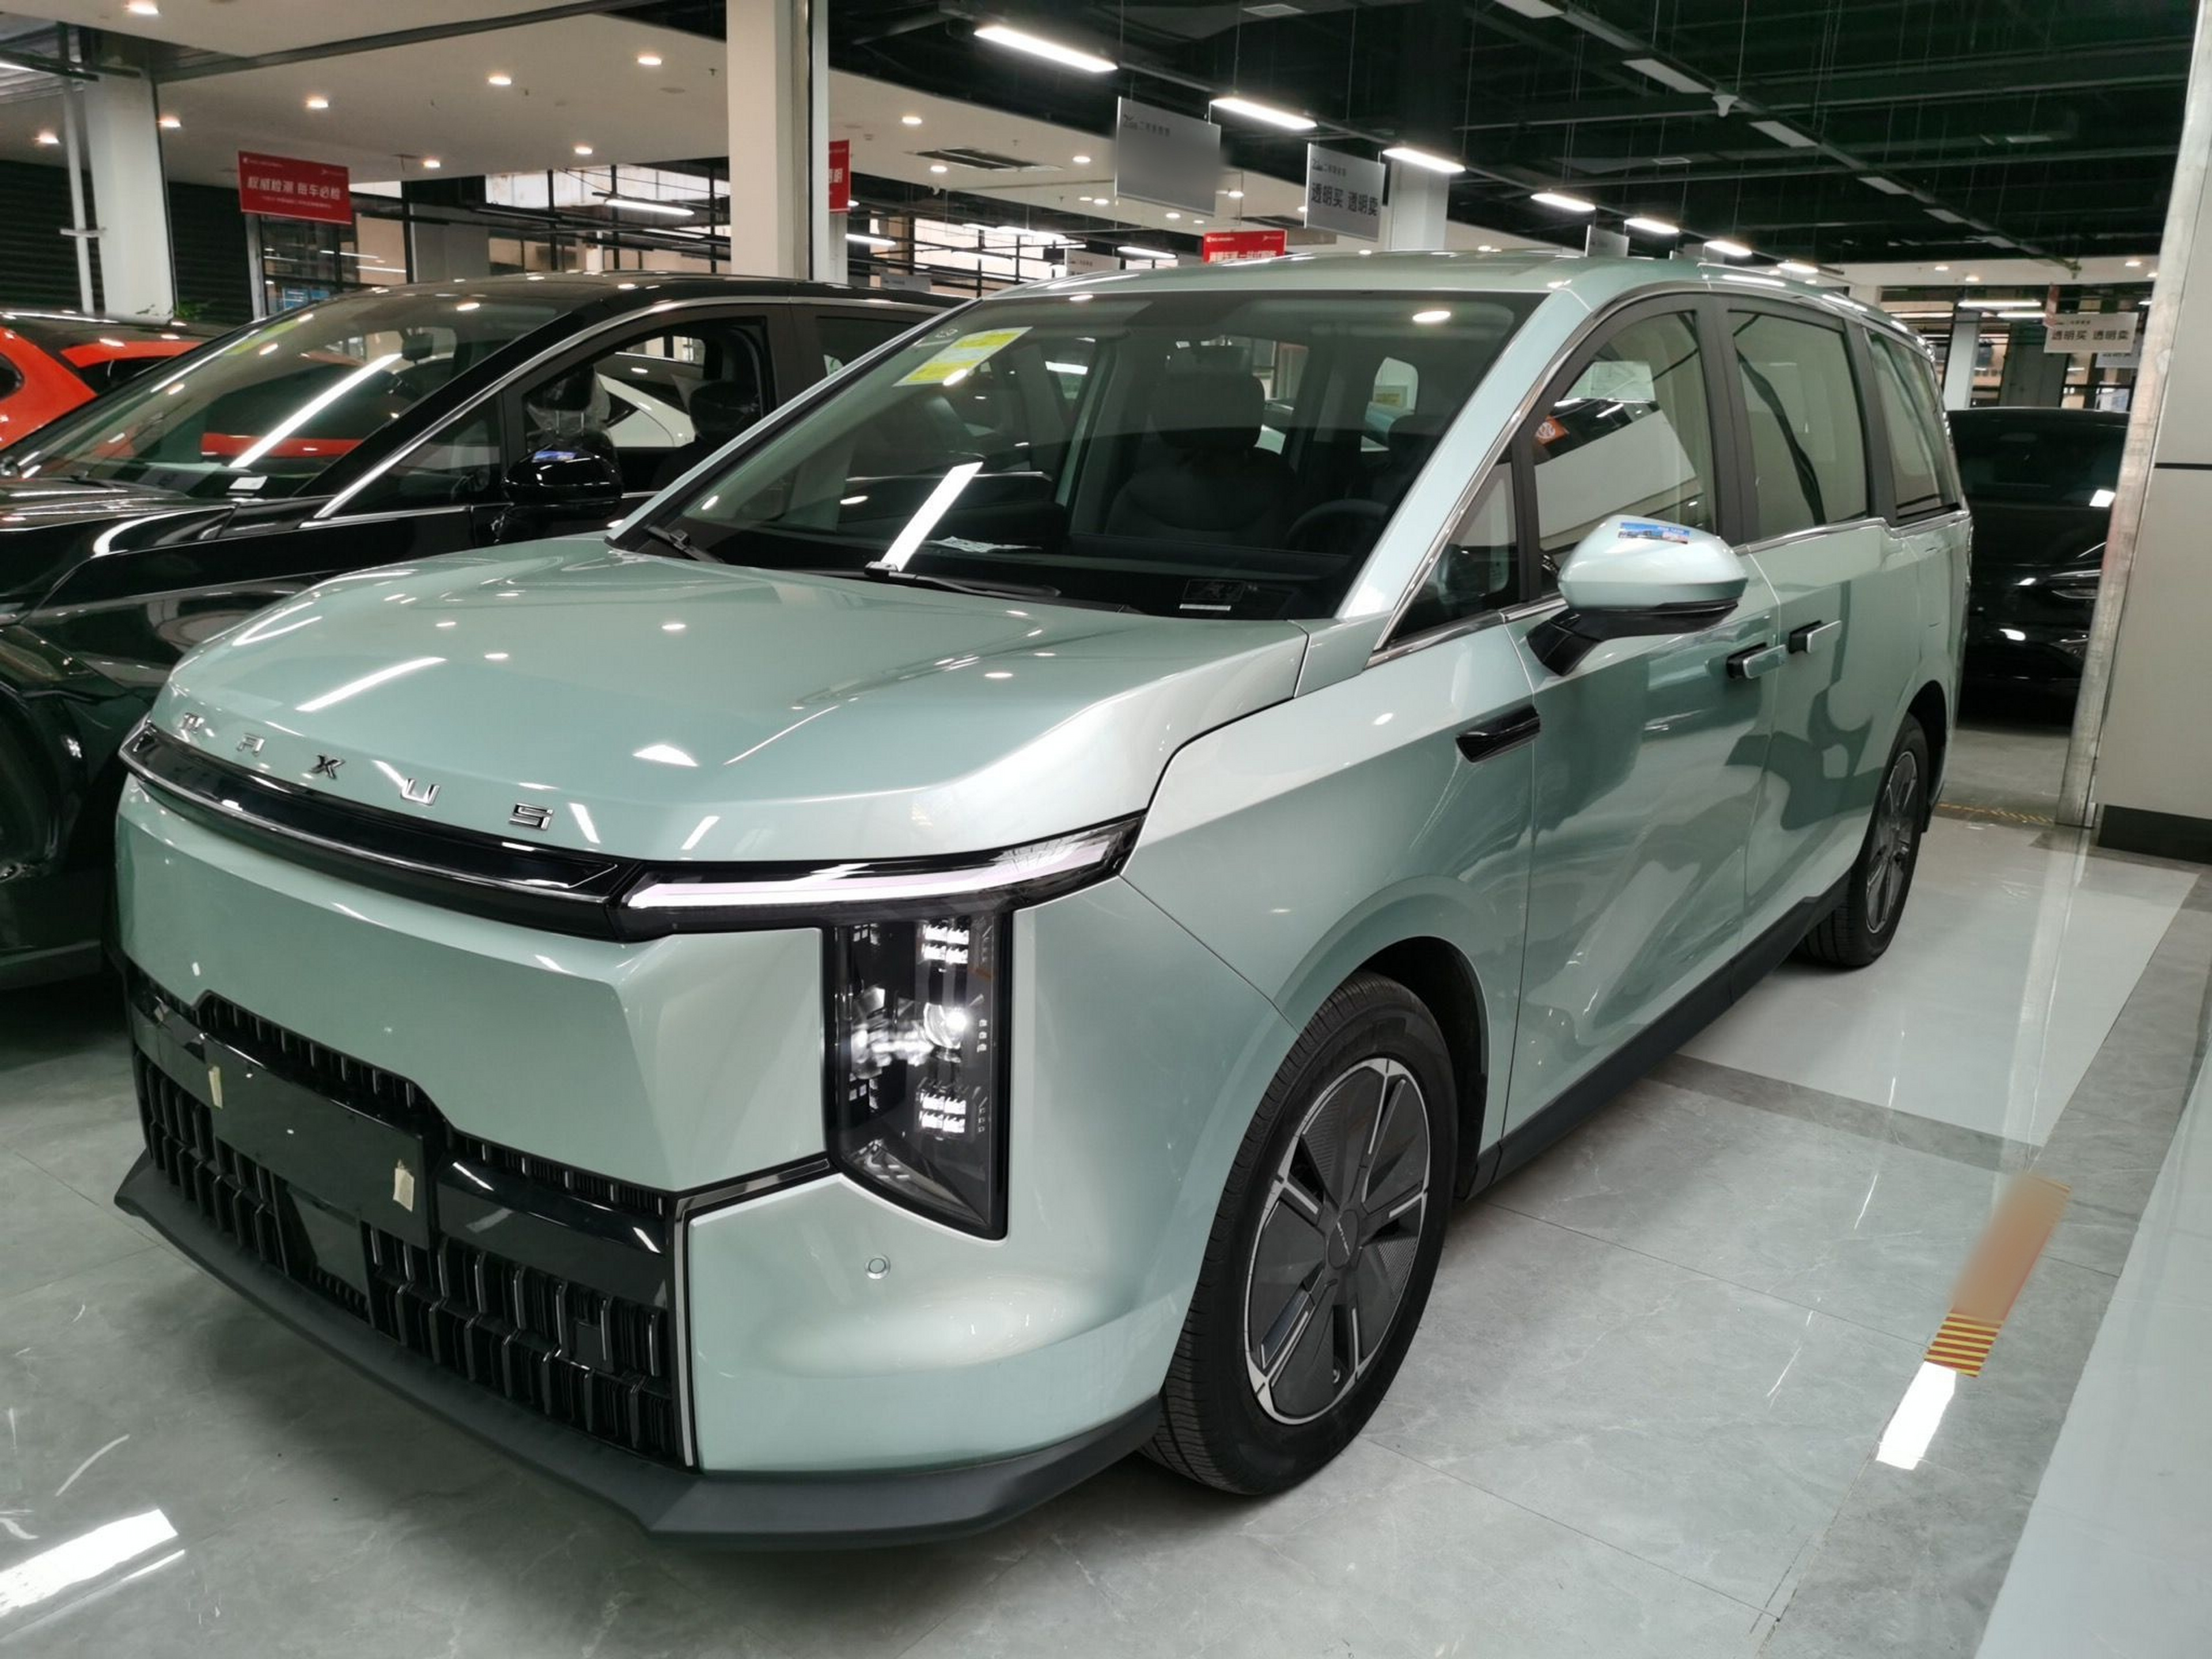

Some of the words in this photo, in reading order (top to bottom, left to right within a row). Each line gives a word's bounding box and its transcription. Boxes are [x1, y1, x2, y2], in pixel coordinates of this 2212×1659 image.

[1312, 182, 1343, 208] 透明买
[1348, 191, 1378, 216] 透明卖
[2051, 330, 2087, 340] 透明买
[2093, 330, 2129, 340] 透明卖
